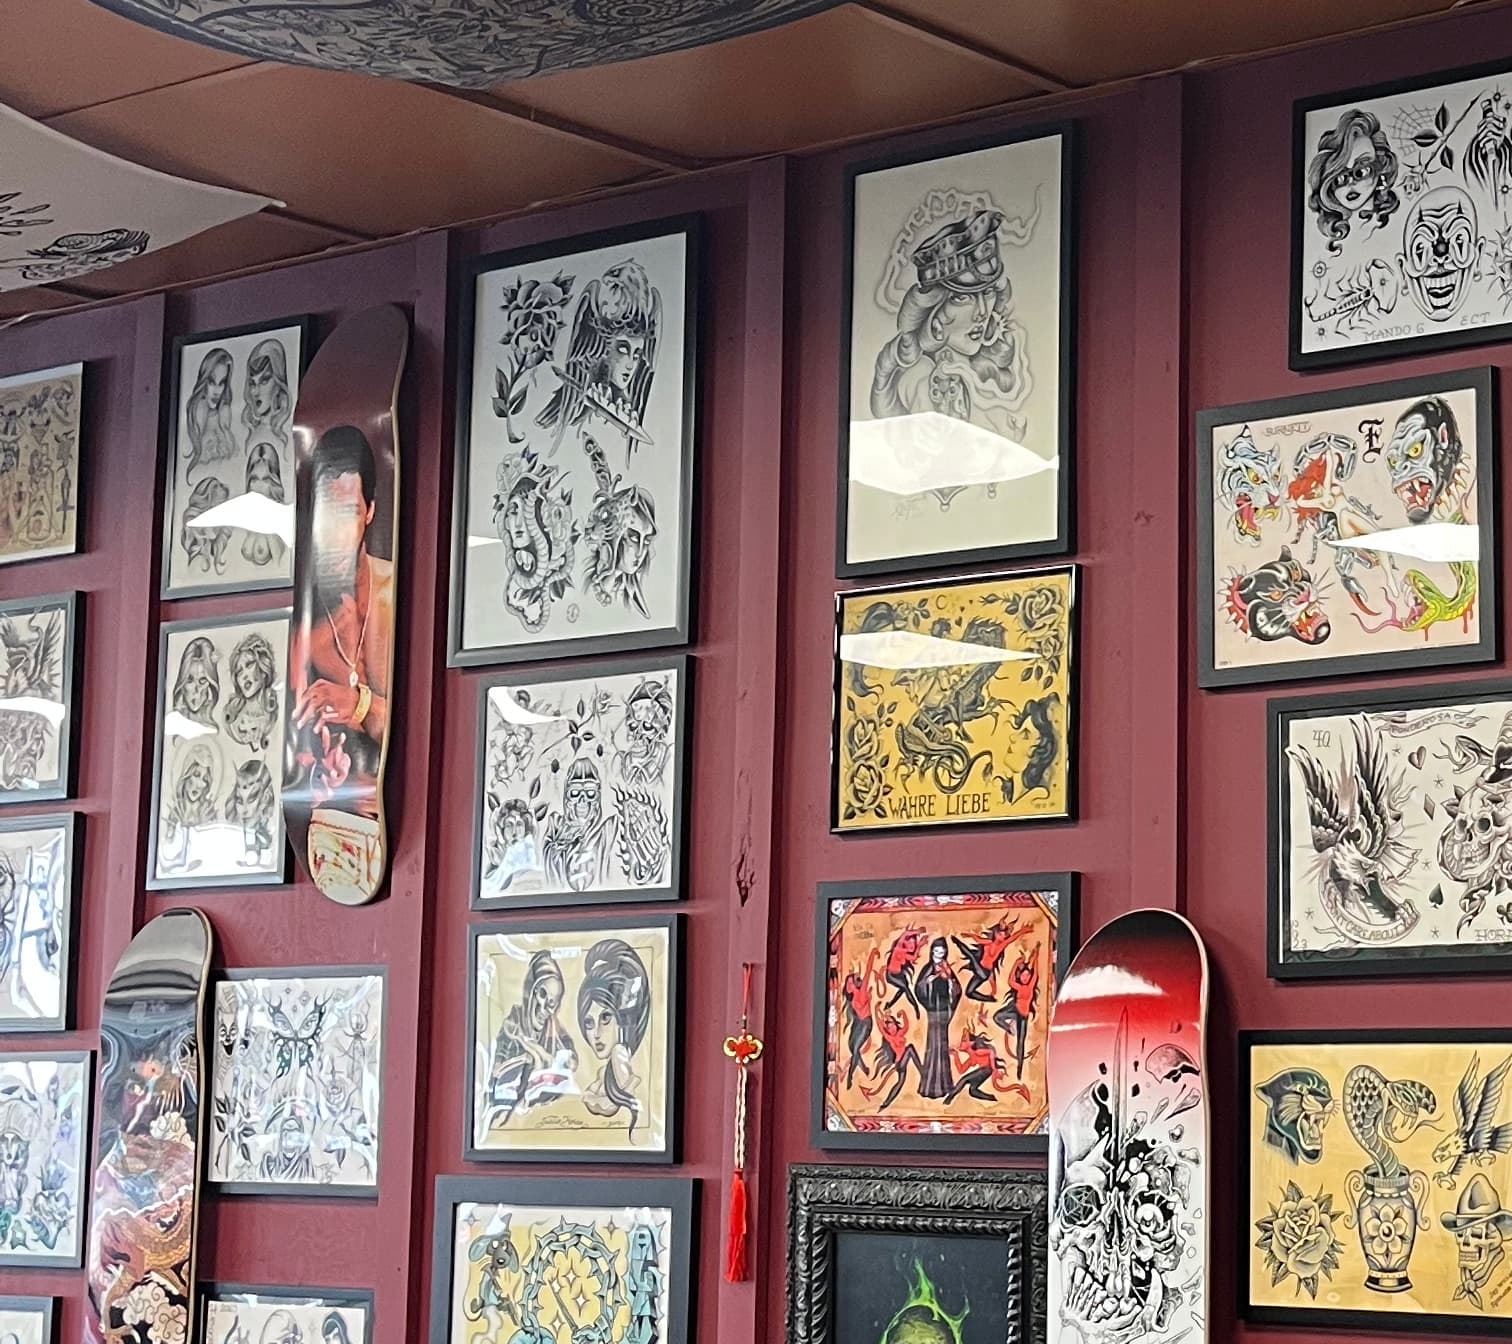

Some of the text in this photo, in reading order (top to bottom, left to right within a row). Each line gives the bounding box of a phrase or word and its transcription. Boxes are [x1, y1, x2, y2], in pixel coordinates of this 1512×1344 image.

[1364, 325, 1411, 343] MANDO
[888, 791, 991, 819] WAHRE LIEBE
